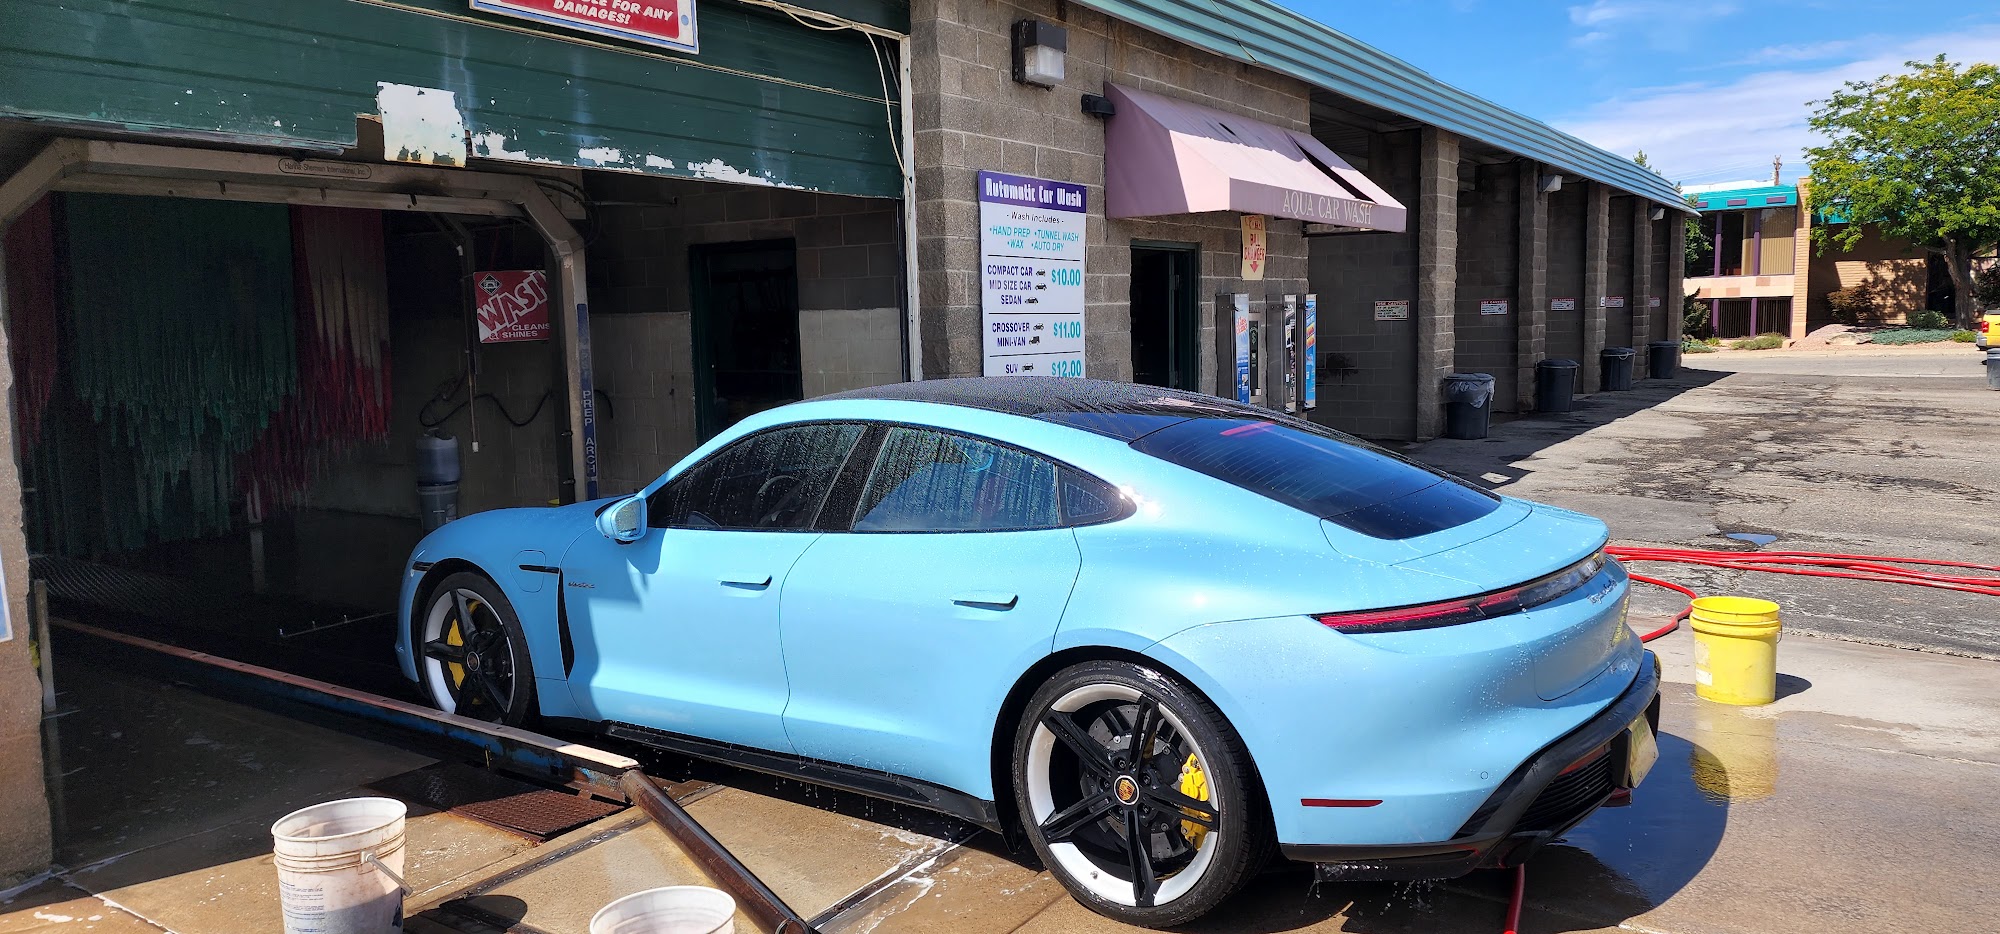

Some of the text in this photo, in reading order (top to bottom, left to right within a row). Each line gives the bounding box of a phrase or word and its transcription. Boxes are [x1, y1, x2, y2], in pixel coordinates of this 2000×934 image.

[553, 0, 631, 24] DAMAGES!
[612, 0, 641, 14] FOR
[643, 6, 673, 21] ANY
[985, 178, 1082, 207] Automatic Car Wash
[1011, 211, 1030, 221] Wash
[1282, 190, 1373, 225] AQUA CAR WASH
[992, 225, 1079, 242] HAND PREP TUNNEL WASH
[1010, 239, 1064, 252] WAX AUTO DRY
[987, 264, 1081, 286] COMPACT CAR $10.00
[989, 279, 1032, 291] MID SIZE CAR
[1000, 294, 1022, 305] SEDAN
[501, 330, 538, 339] SHINES
[512, 323, 550, 331] CLEANS
[991, 321, 1081, 339] CROSSOVER $11.00
[997, 336, 1026, 347] MINI-VAN
[1005, 360, 1081, 378] SUV $12.00
[583, 390, 592, 426] PREP
